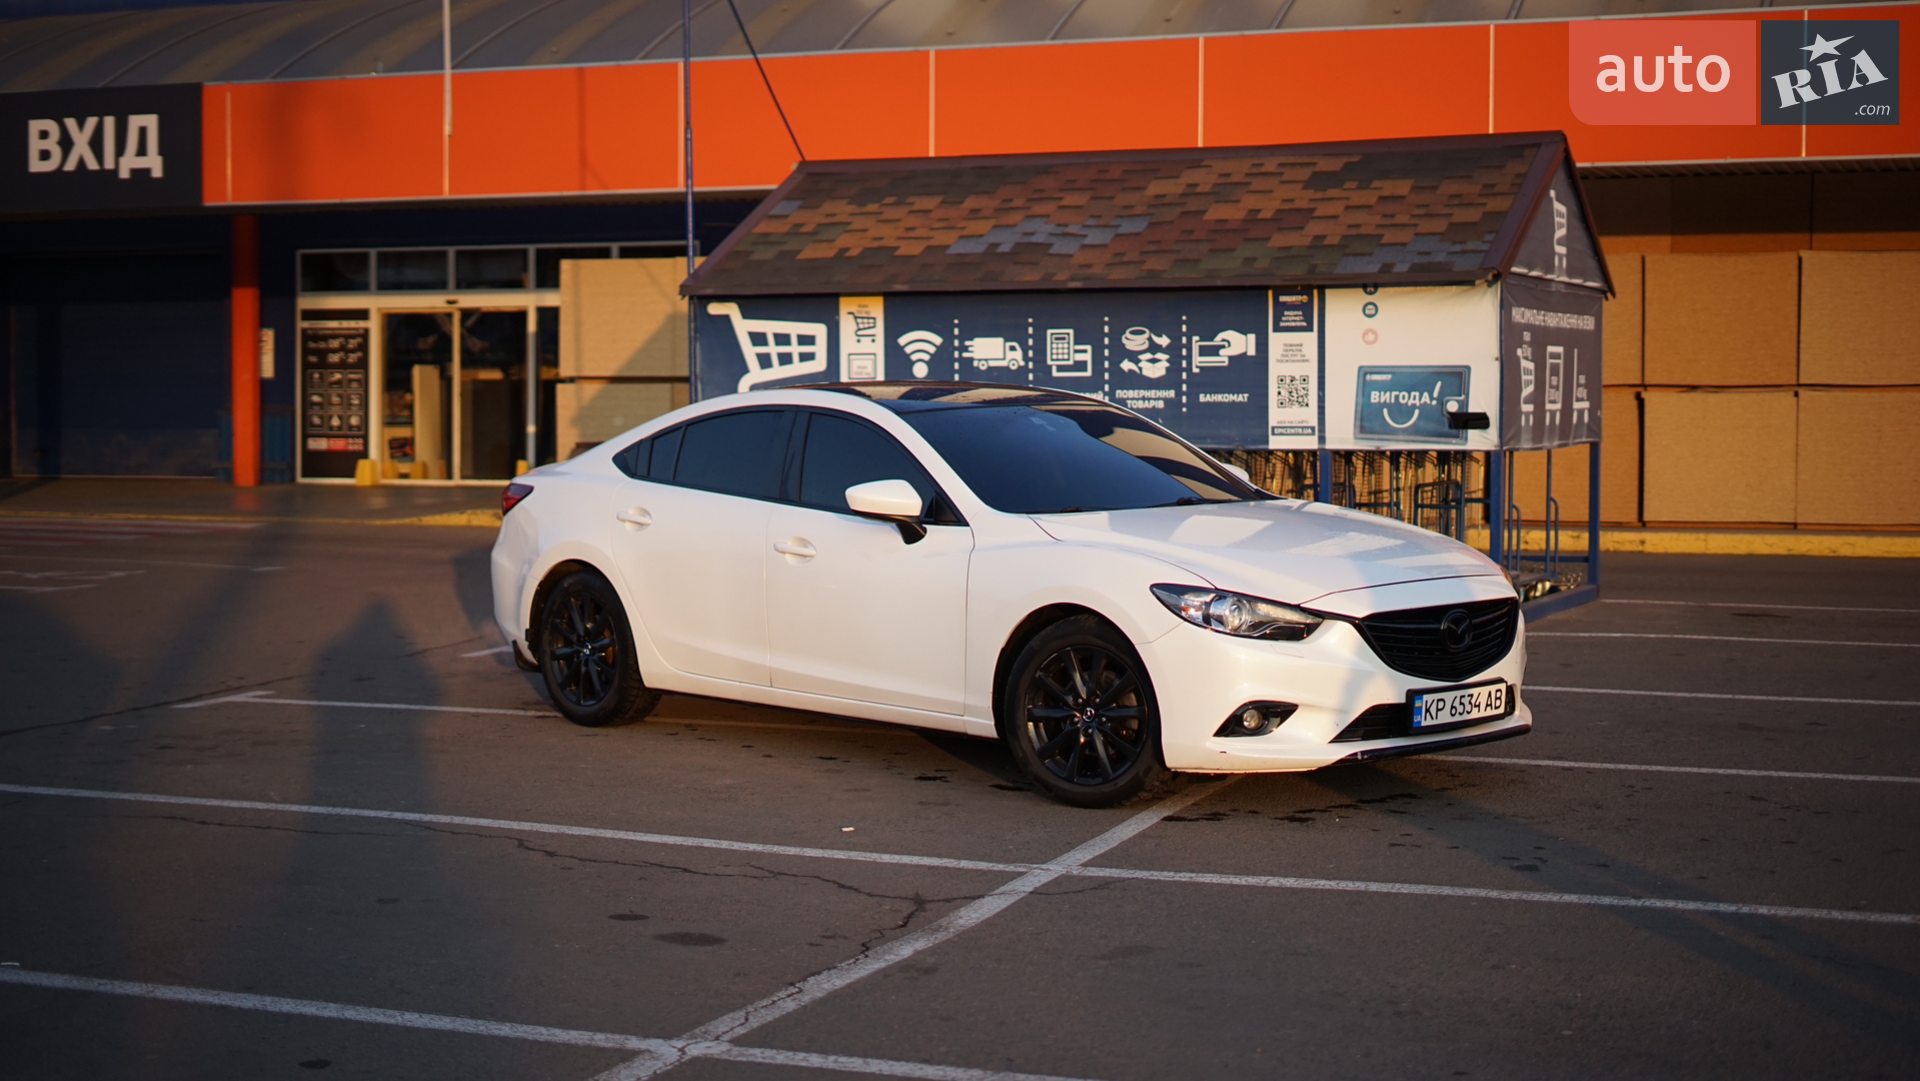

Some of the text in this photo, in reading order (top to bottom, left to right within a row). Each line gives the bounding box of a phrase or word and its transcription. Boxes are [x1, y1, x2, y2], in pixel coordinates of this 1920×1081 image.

[27, 113, 164, 179] ВХІД
[1115, 389, 1176, 399] ПОВЕРНЕННЯ
[1199, 393, 1250, 403] БАНКОМАТ
[1370, 380, 1442, 406] ВИГОДА!
[1126, 400, 1165, 409] ТОВАРІВ
[1424, 698, 1446, 721] KP
[1450, 692, 1481, 717] 6534
[1484, 689, 1503, 712] AB
